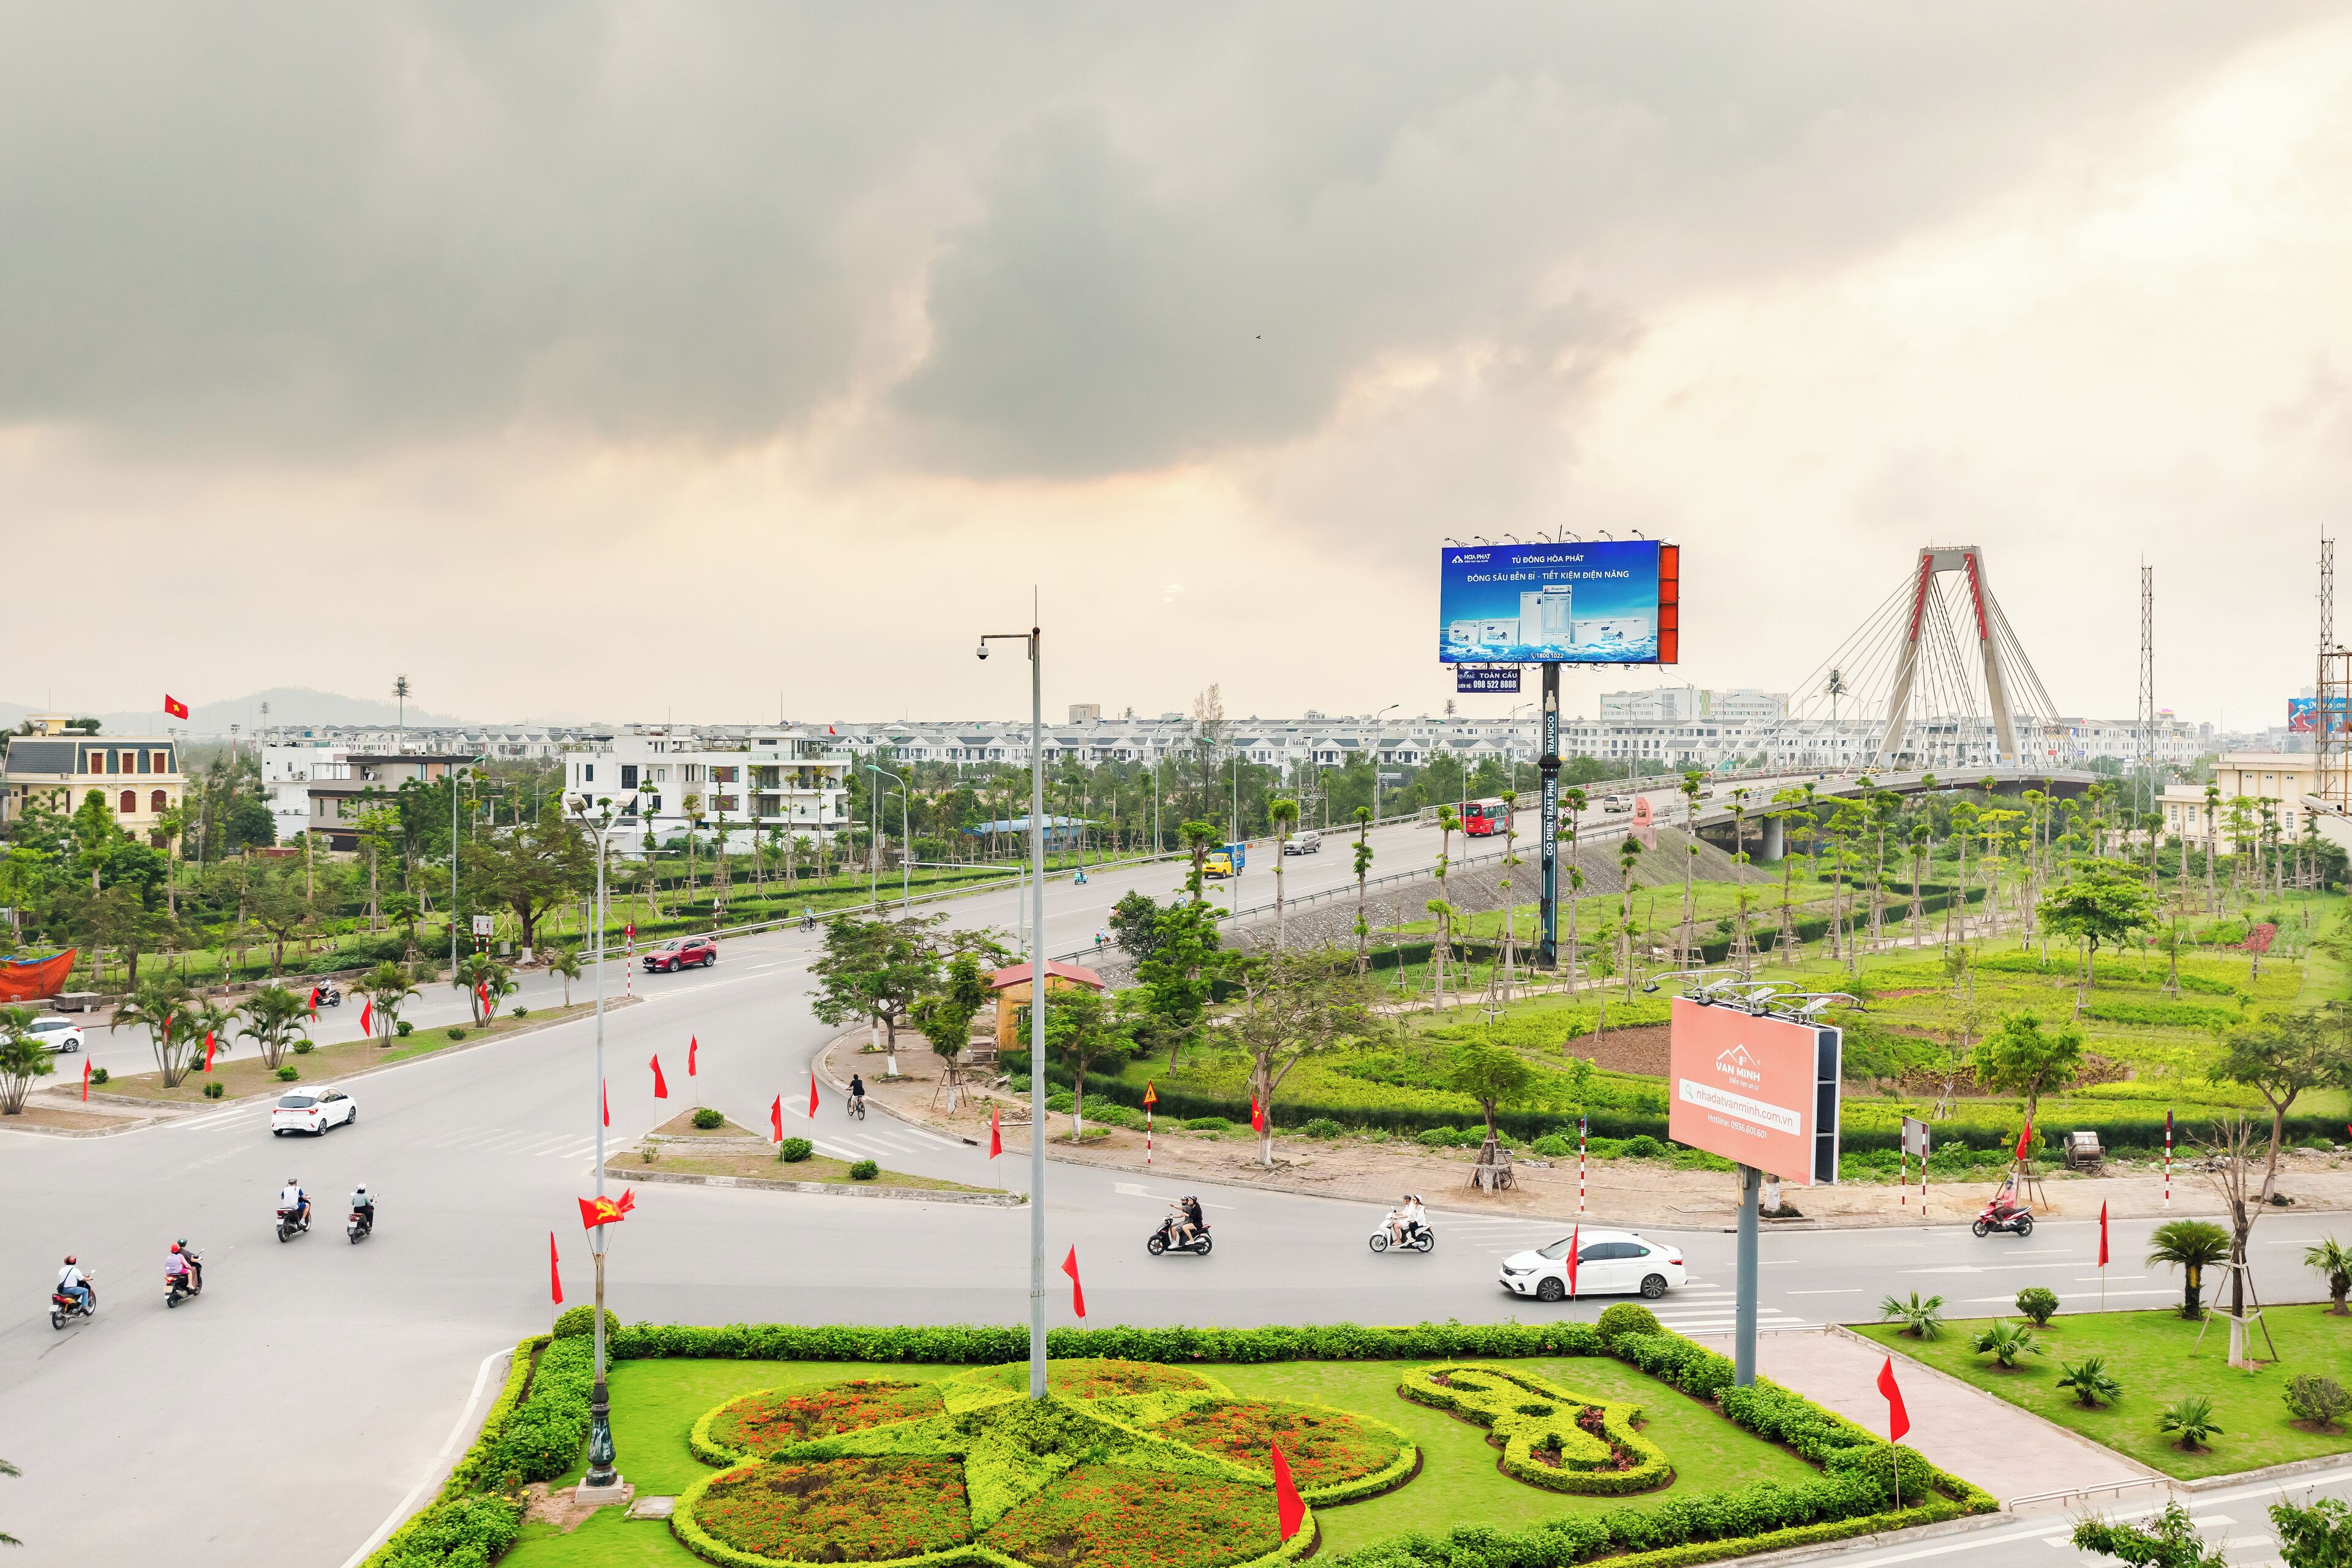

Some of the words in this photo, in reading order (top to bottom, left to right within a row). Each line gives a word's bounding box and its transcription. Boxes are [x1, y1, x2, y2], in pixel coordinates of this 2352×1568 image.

[1467, 573, 1491, 582] ĐÔNG
[1493, 573, 1508, 581] SÂU
[1542, 570, 1558, 579] TIẾT
[1561, 570, 1580, 581] KIỆM
[1583, 570, 1602, 581] ĐIỆN
[1605, 569, 1629, 578] NĂNG
[1473, 680, 1485, 688] 098
[1487, 680, 1499, 688] 522
[1500, 680, 1517, 688] 8888
[1546, 842, 1553, 856] CO
[1716, 1060, 1735, 1075] VAN
[1736, 1066, 1760, 1082] MINH
[1697, 1088, 1793, 1127] nhadatvanminh.com.vn
[1708, 1113, 1730, 1128] Hotline:
[1730, 1120, 1767, 1139] 0936.601.601
